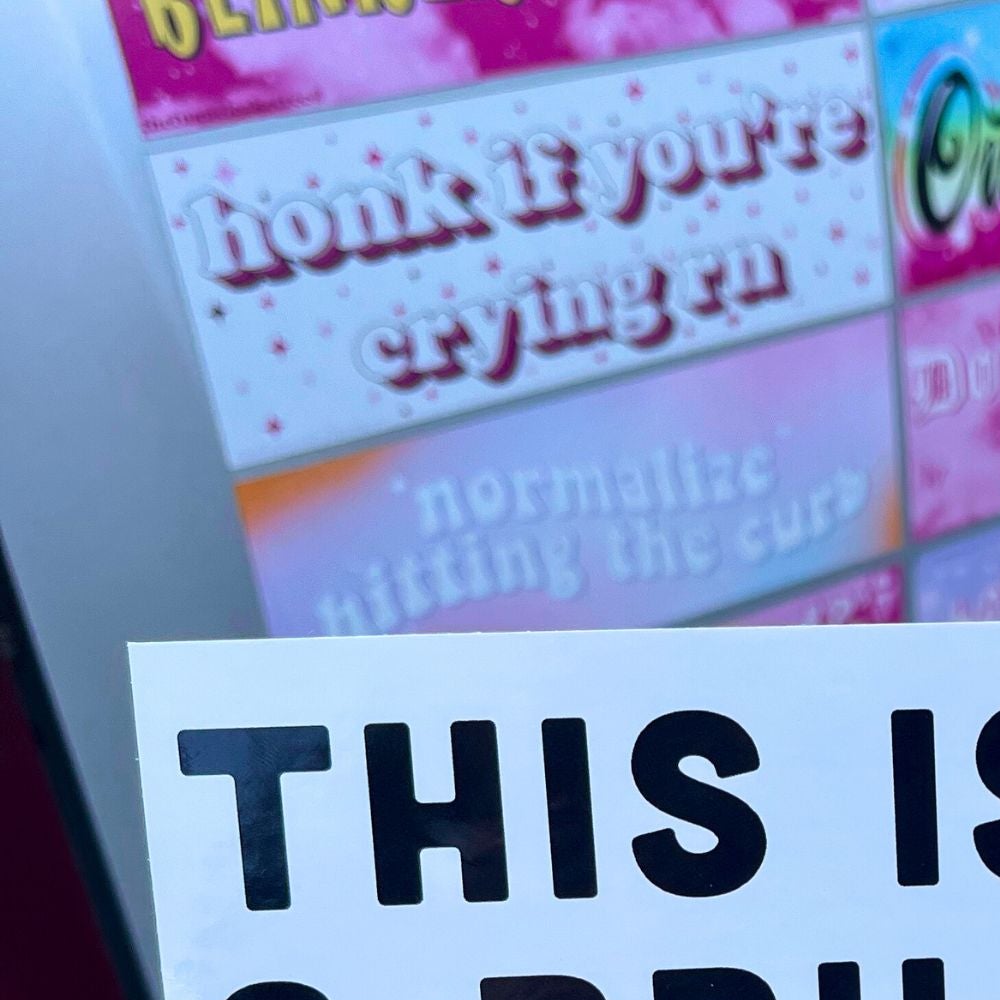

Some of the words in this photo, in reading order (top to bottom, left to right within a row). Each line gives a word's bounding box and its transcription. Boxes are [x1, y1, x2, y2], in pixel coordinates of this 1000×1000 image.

[188, 155, 491, 287] honk
[486, 130, 585, 228] if
[584, 90, 868, 227] you're
[358, 262, 675, 390] crying
[674, 240, 790, 317] rn
[412, 440, 777, 537] normalize
[606, 516, 722, 583] the
[178, 710, 767, 911] THIS
